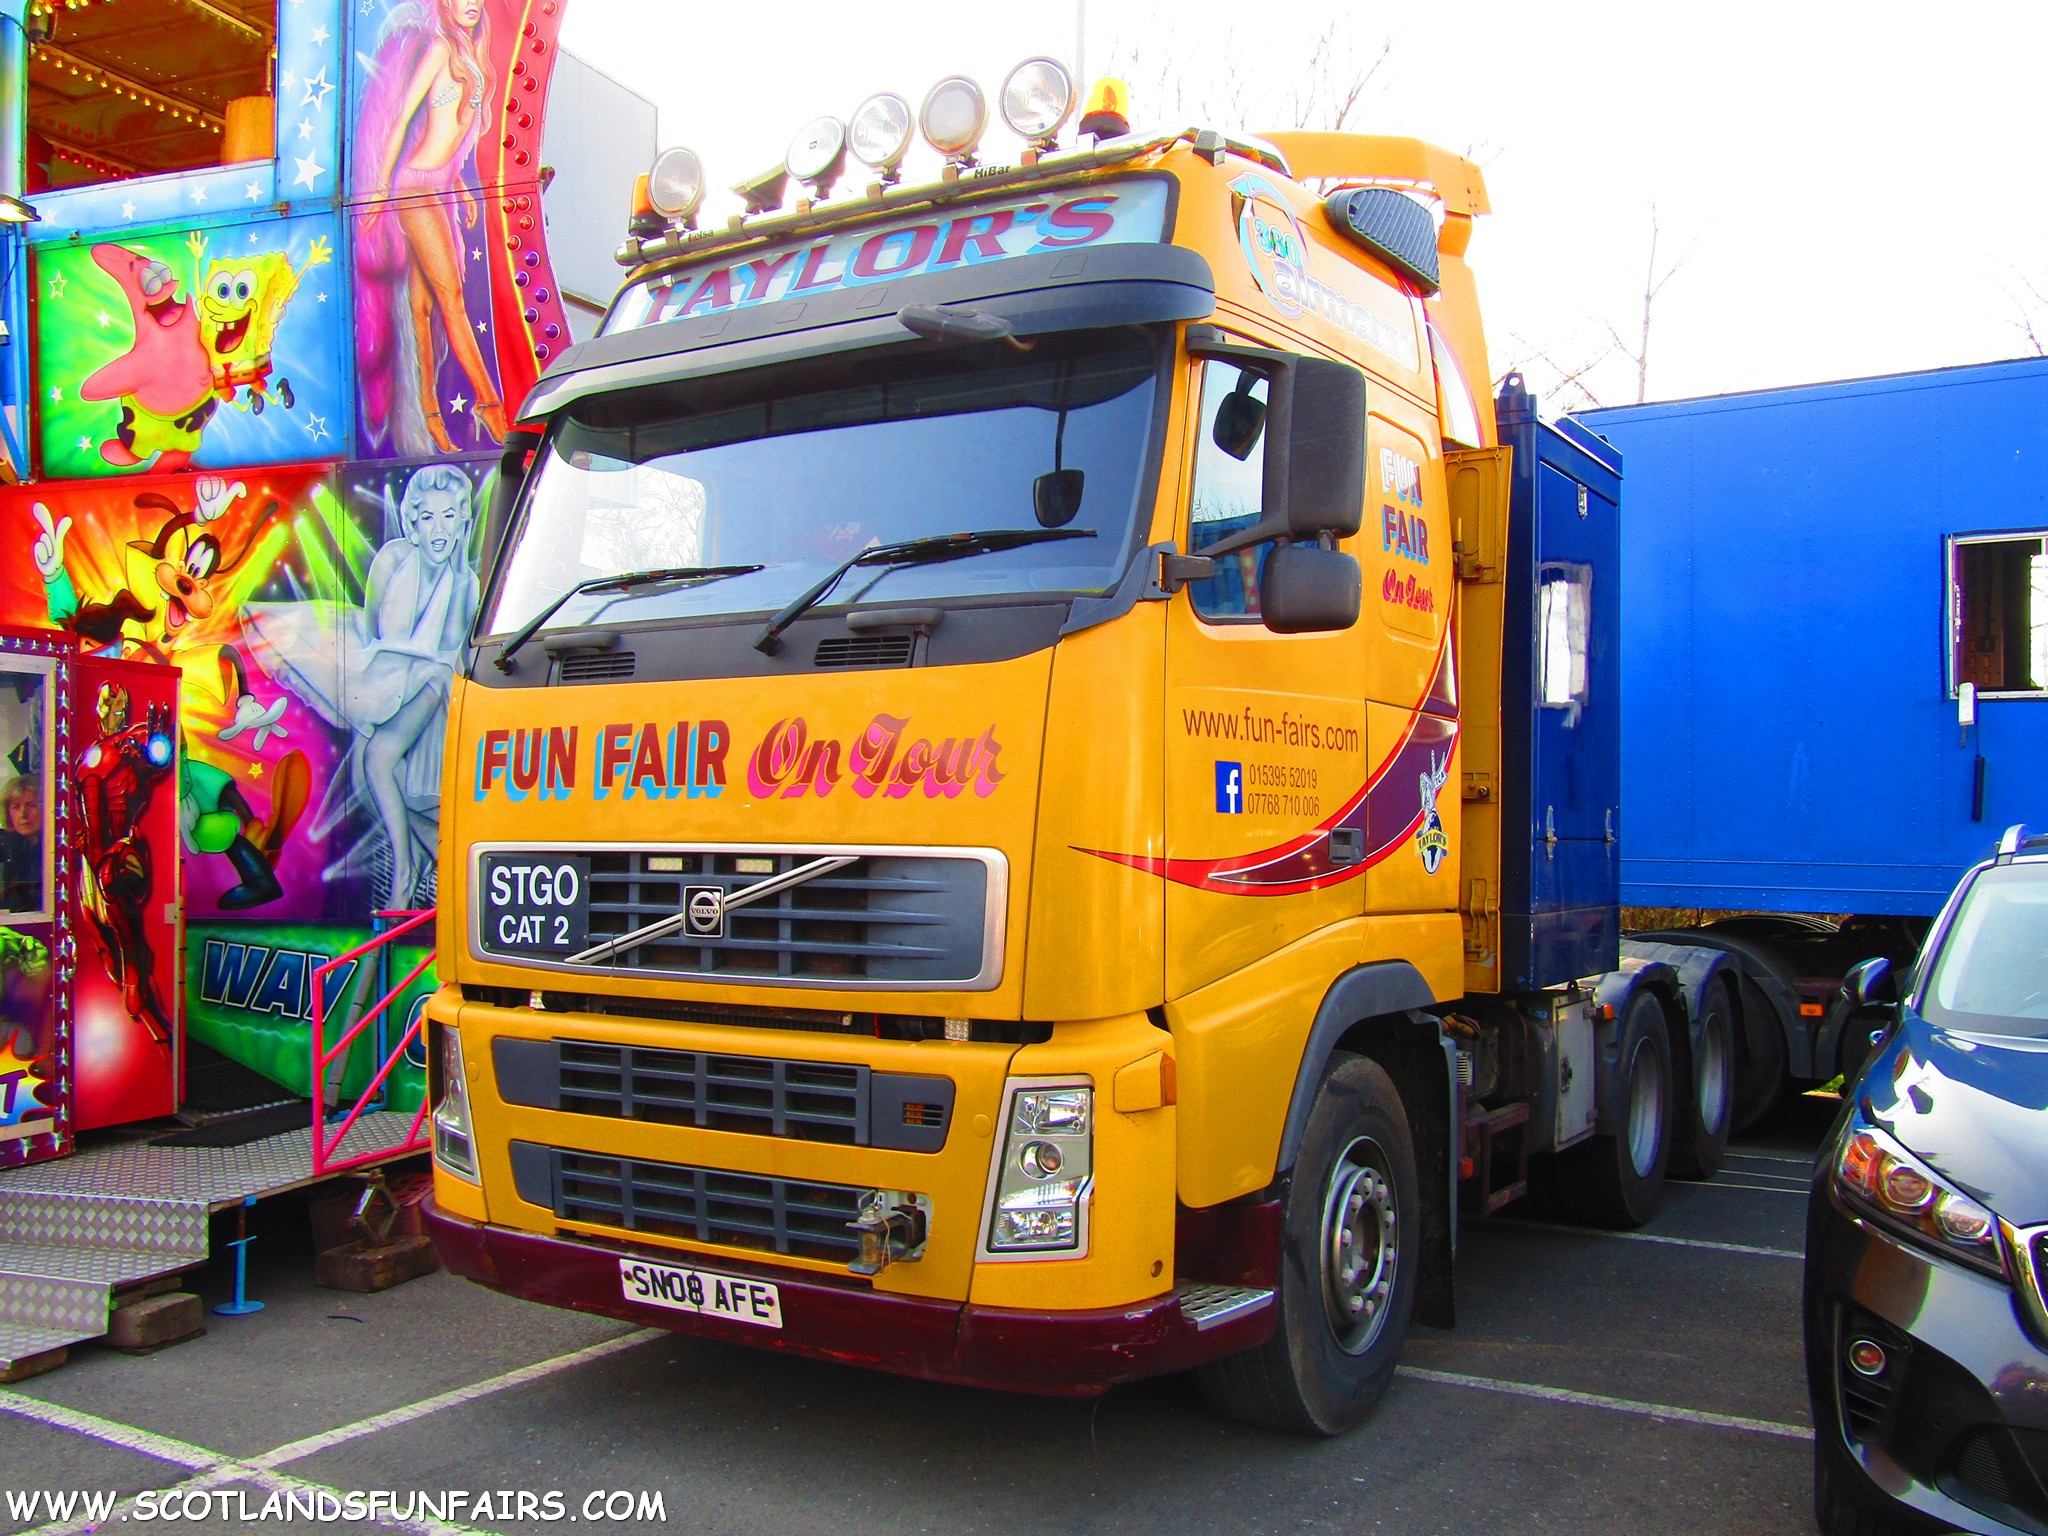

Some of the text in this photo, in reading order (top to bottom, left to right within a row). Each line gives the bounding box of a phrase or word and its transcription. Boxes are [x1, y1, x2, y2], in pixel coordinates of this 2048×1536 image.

[974, 165, 1011, 178] HiBar
[637, 195, 1120, 327] TAYLOR'S
[1253, 216, 1302, 269] 380
[1380, 447, 1422, 508] FUN
[1381, 504, 1429, 565] FAIR
[1383, 568, 1404, 604] On
[1183, 706, 1359, 753] www.fun-fairs.com
[474, 713, 1008, 802] FUN FAIR On Tour
[1250, 763, 1318, 790] 015395 52019
[1247, 792, 1320, 817] 07768 710 006
[490, 864, 579, 906] STGO
[499, 914, 570, 945] CAT 2
[201, 939, 359, 1024] WAY
[632, 1264, 770, 1319] SN08 AFE
